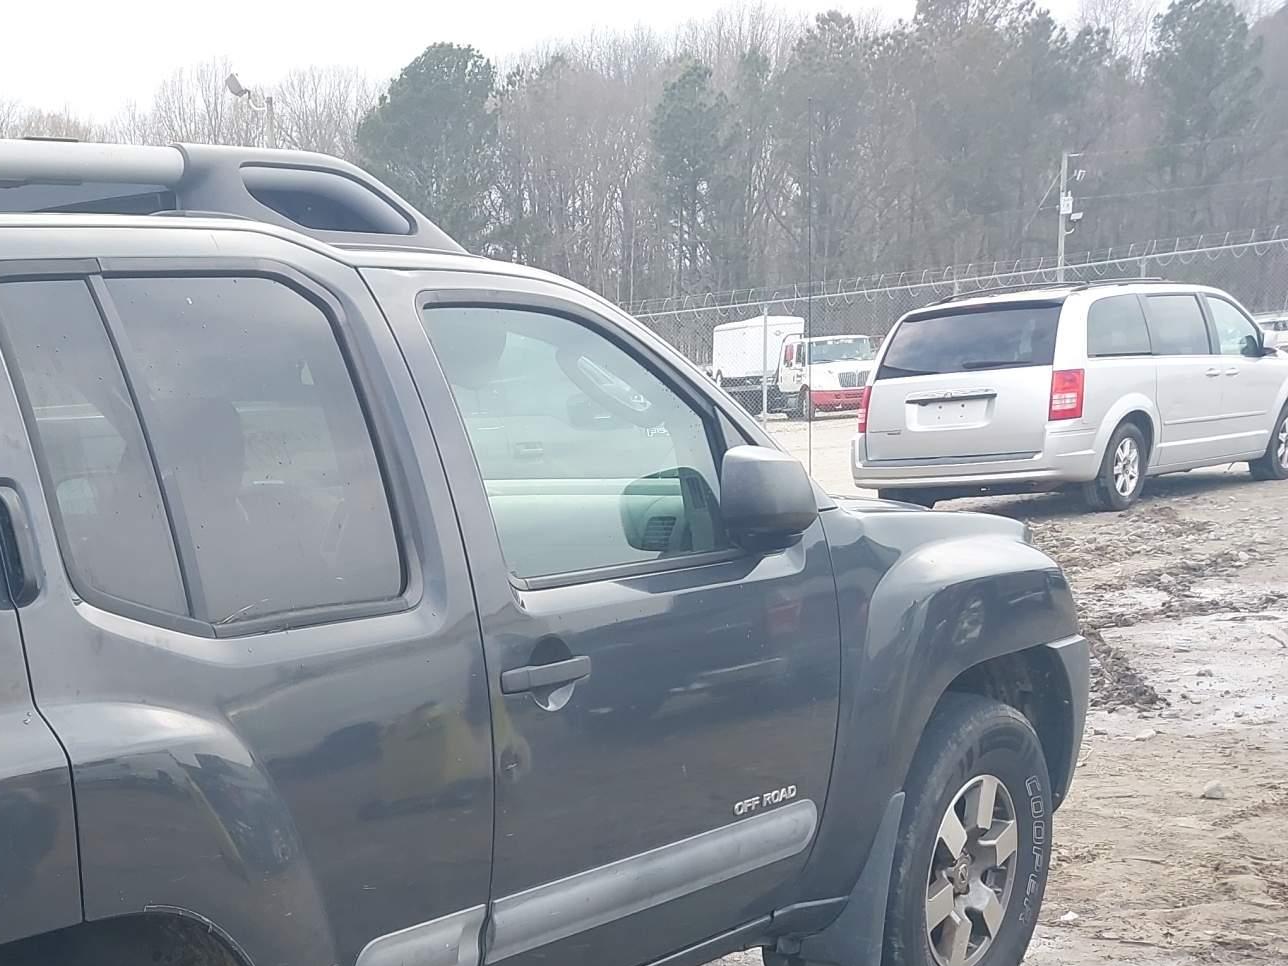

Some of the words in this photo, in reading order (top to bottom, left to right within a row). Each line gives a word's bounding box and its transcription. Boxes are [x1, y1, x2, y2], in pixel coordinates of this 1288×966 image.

[733, 796, 760, 816] OFF
[762, 784, 797, 807] ROAD
[1018, 774, 1045, 925] COOPER
